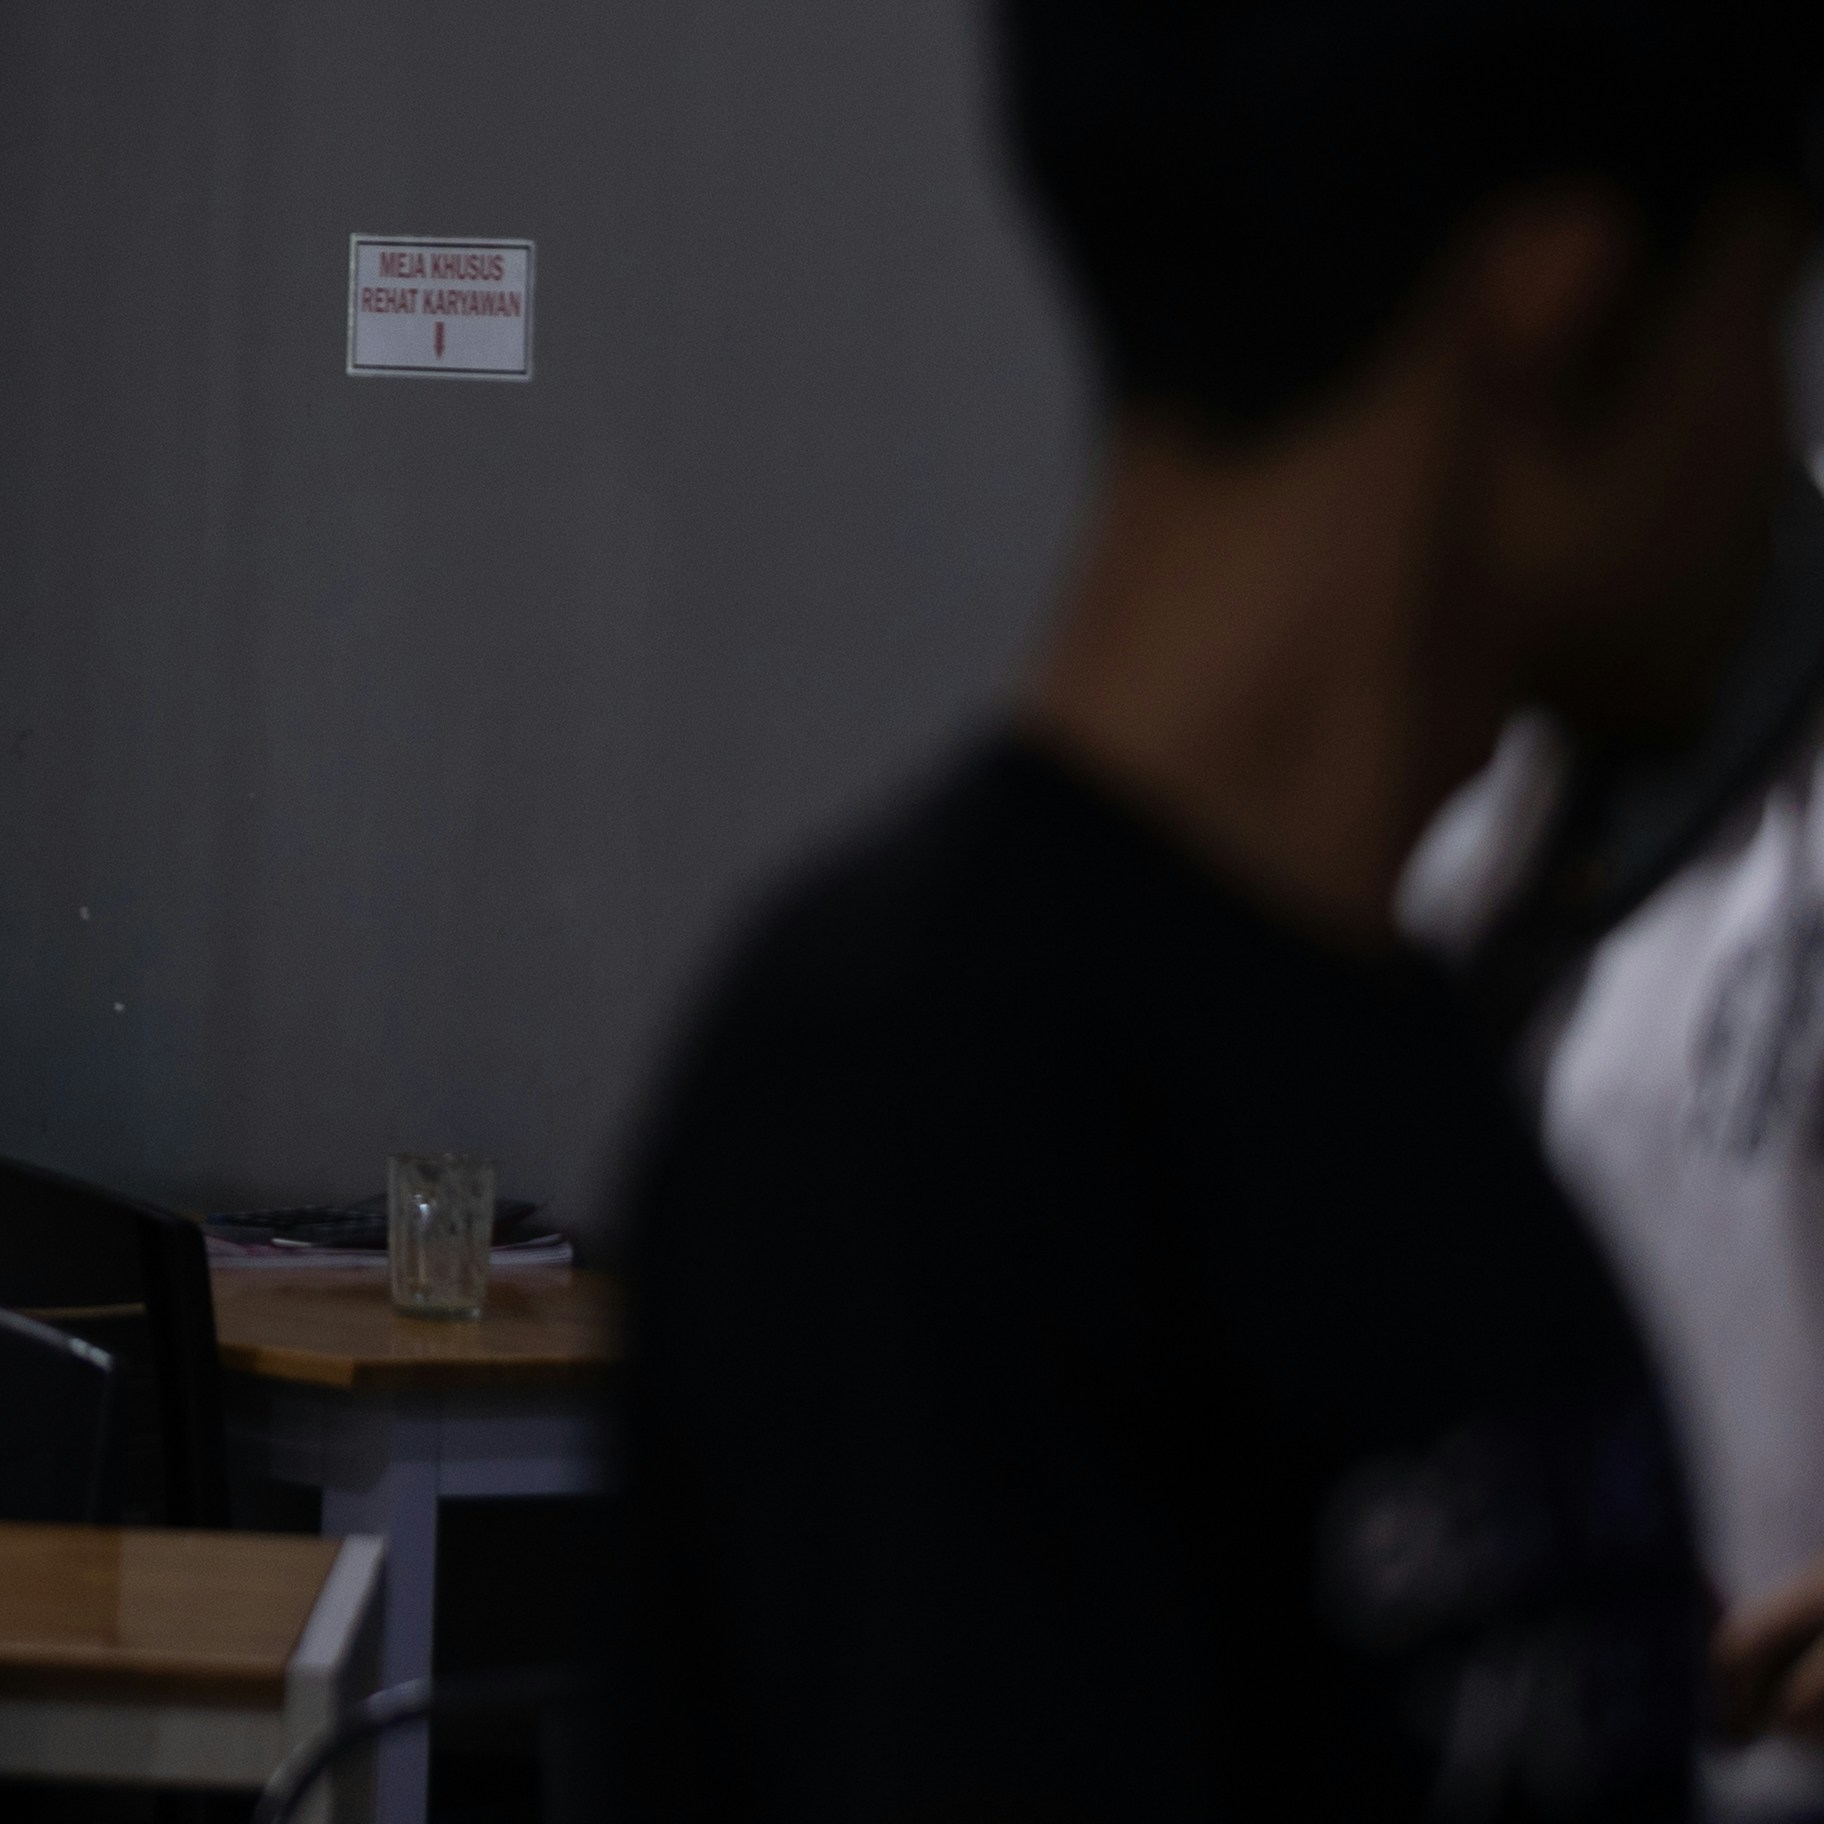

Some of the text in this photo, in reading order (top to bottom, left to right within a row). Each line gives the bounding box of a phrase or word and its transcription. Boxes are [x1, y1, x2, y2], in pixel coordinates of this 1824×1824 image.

[379, 251, 504, 282] MEJA KHUSUS
[361, 286, 522, 318] REHAT KARYAWAN
